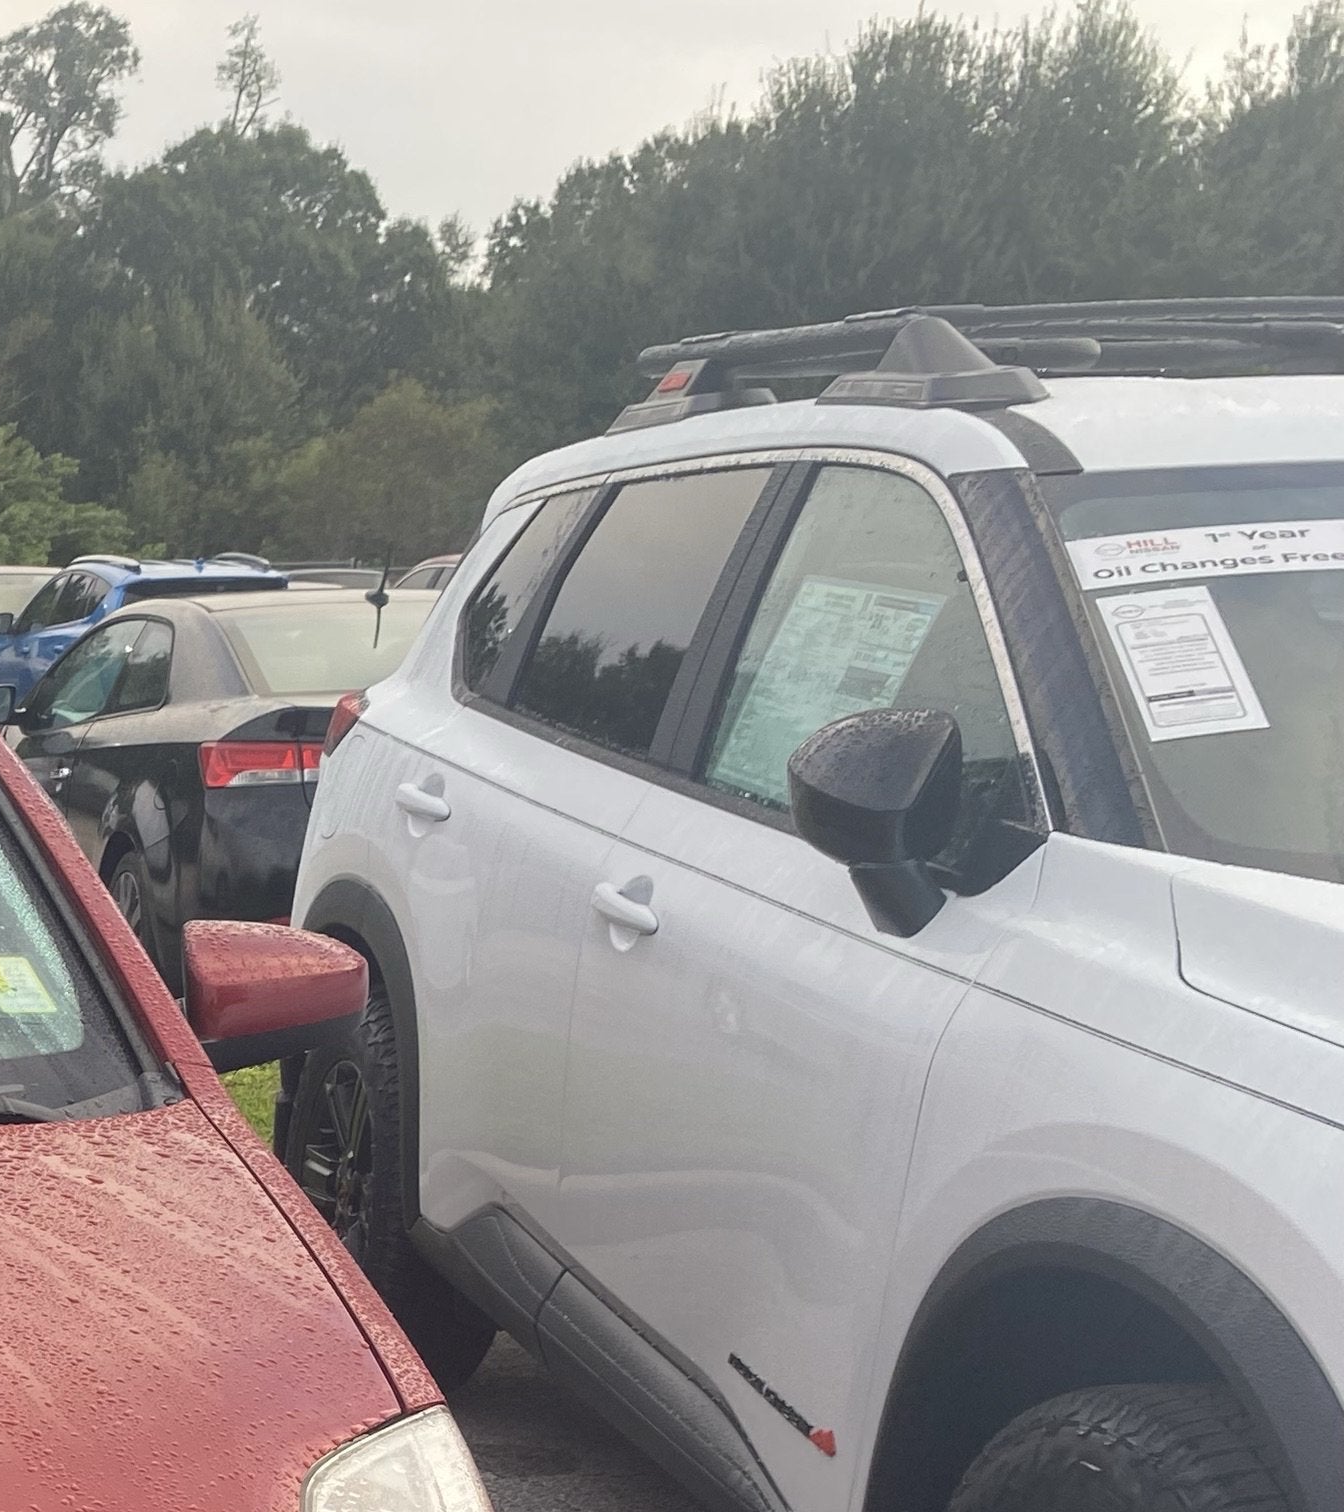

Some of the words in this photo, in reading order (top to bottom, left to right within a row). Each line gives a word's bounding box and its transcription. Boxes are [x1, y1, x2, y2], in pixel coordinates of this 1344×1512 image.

[1238, 529, 1311, 540] Year
[1126, 537, 1178, 549] HILL
[1093, 566, 1132, 579] Oil
[1140, 554, 1275, 574] Changes
[1281, 552, 1344, 563] Free
